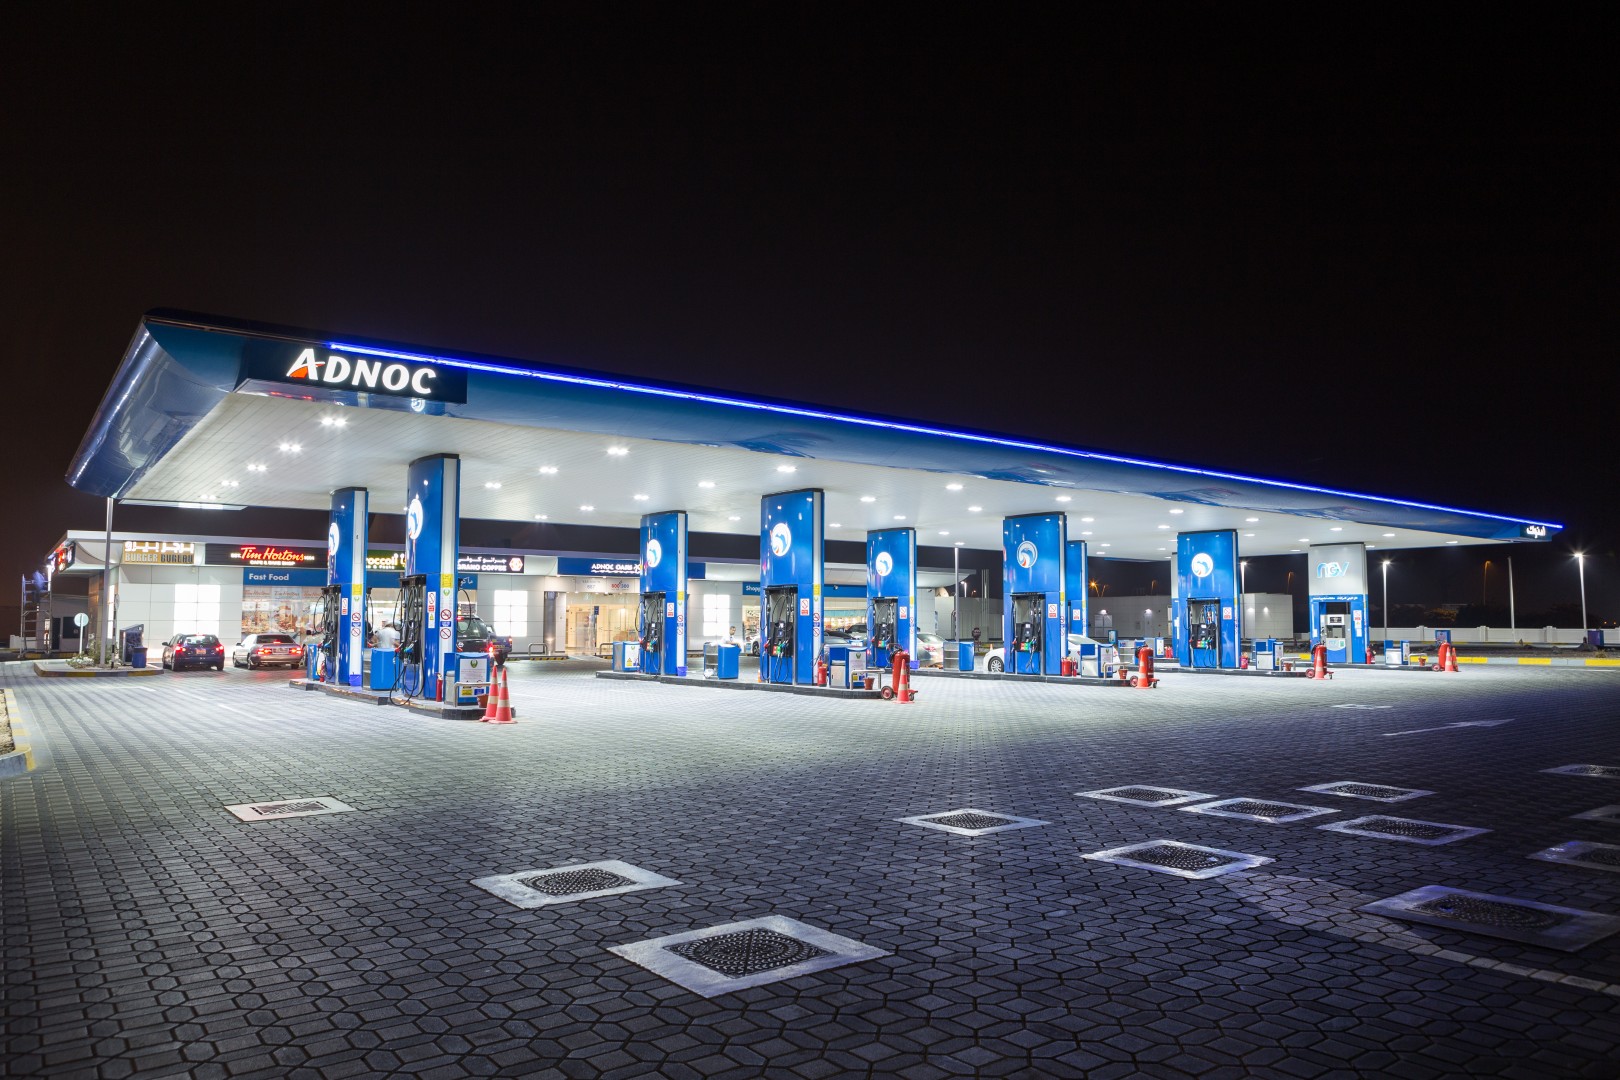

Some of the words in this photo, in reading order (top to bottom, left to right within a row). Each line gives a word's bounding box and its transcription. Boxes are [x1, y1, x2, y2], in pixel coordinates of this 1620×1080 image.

[286, 348, 437, 394] ADNOC
[126, 553, 158, 563] BURGER
[241, 546, 261, 560] Tim
[262, 547, 305, 562] Hortons
[268, 573, 290, 581] Food
